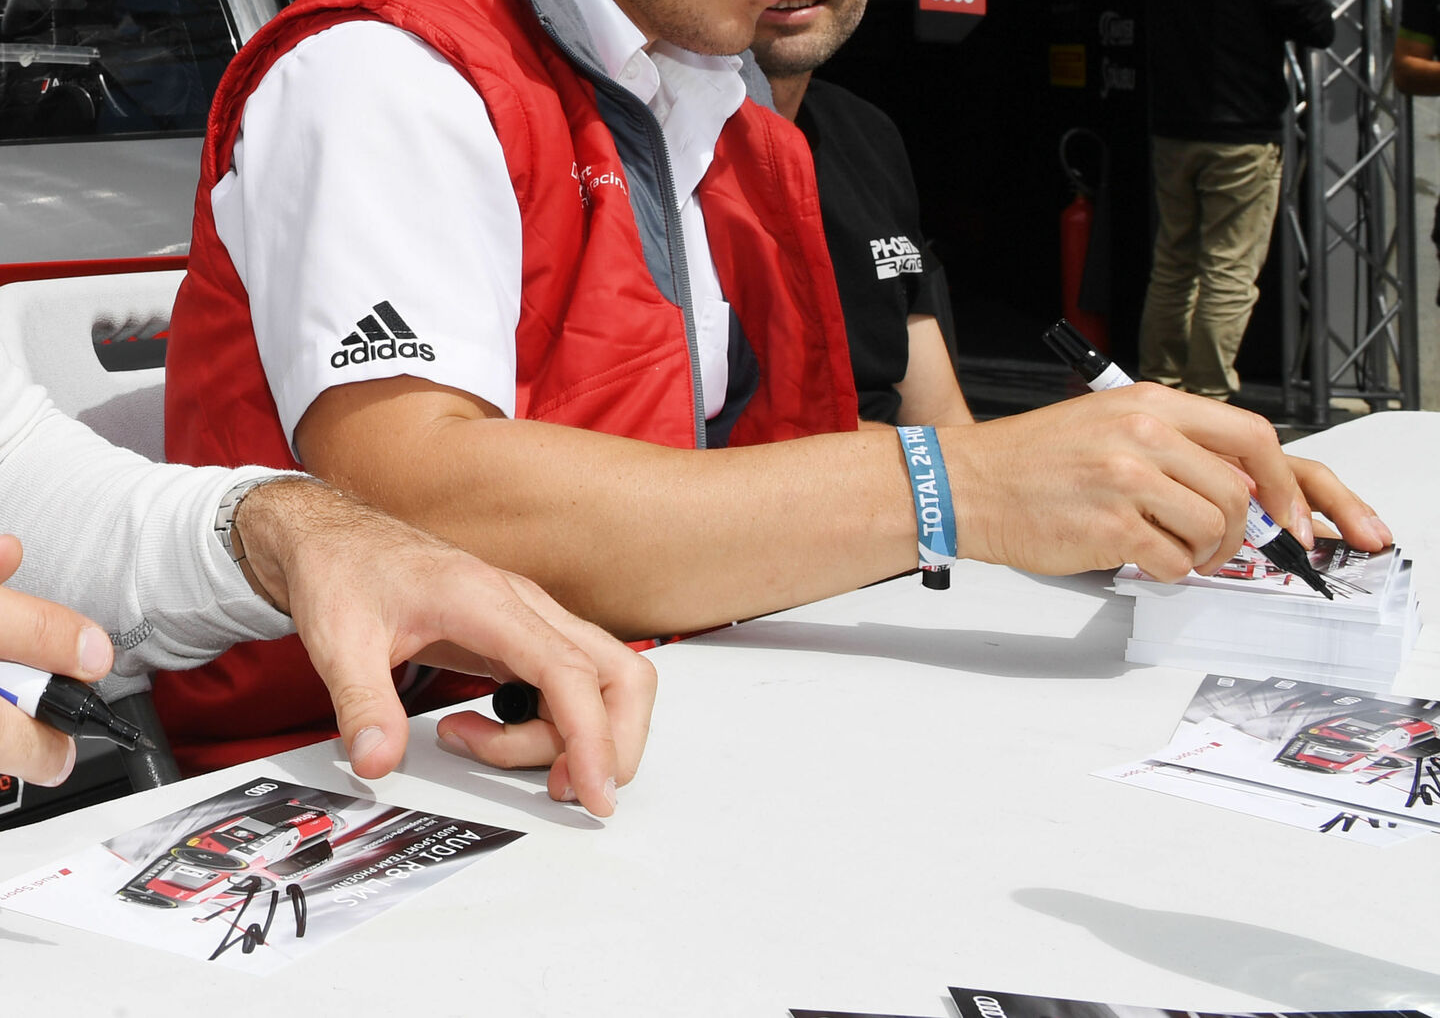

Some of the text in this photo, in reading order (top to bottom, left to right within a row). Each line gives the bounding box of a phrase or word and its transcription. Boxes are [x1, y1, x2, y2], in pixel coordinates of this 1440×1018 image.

[330, 338, 436, 369] adidas
[910, 445, 933, 467] 24
[916, 469, 944, 537] TOTAL
[327, 825, 459, 892] AUDI SPORT TEAM PHOENIX
[333, 828, 482, 908] AUDI R8 LMS
